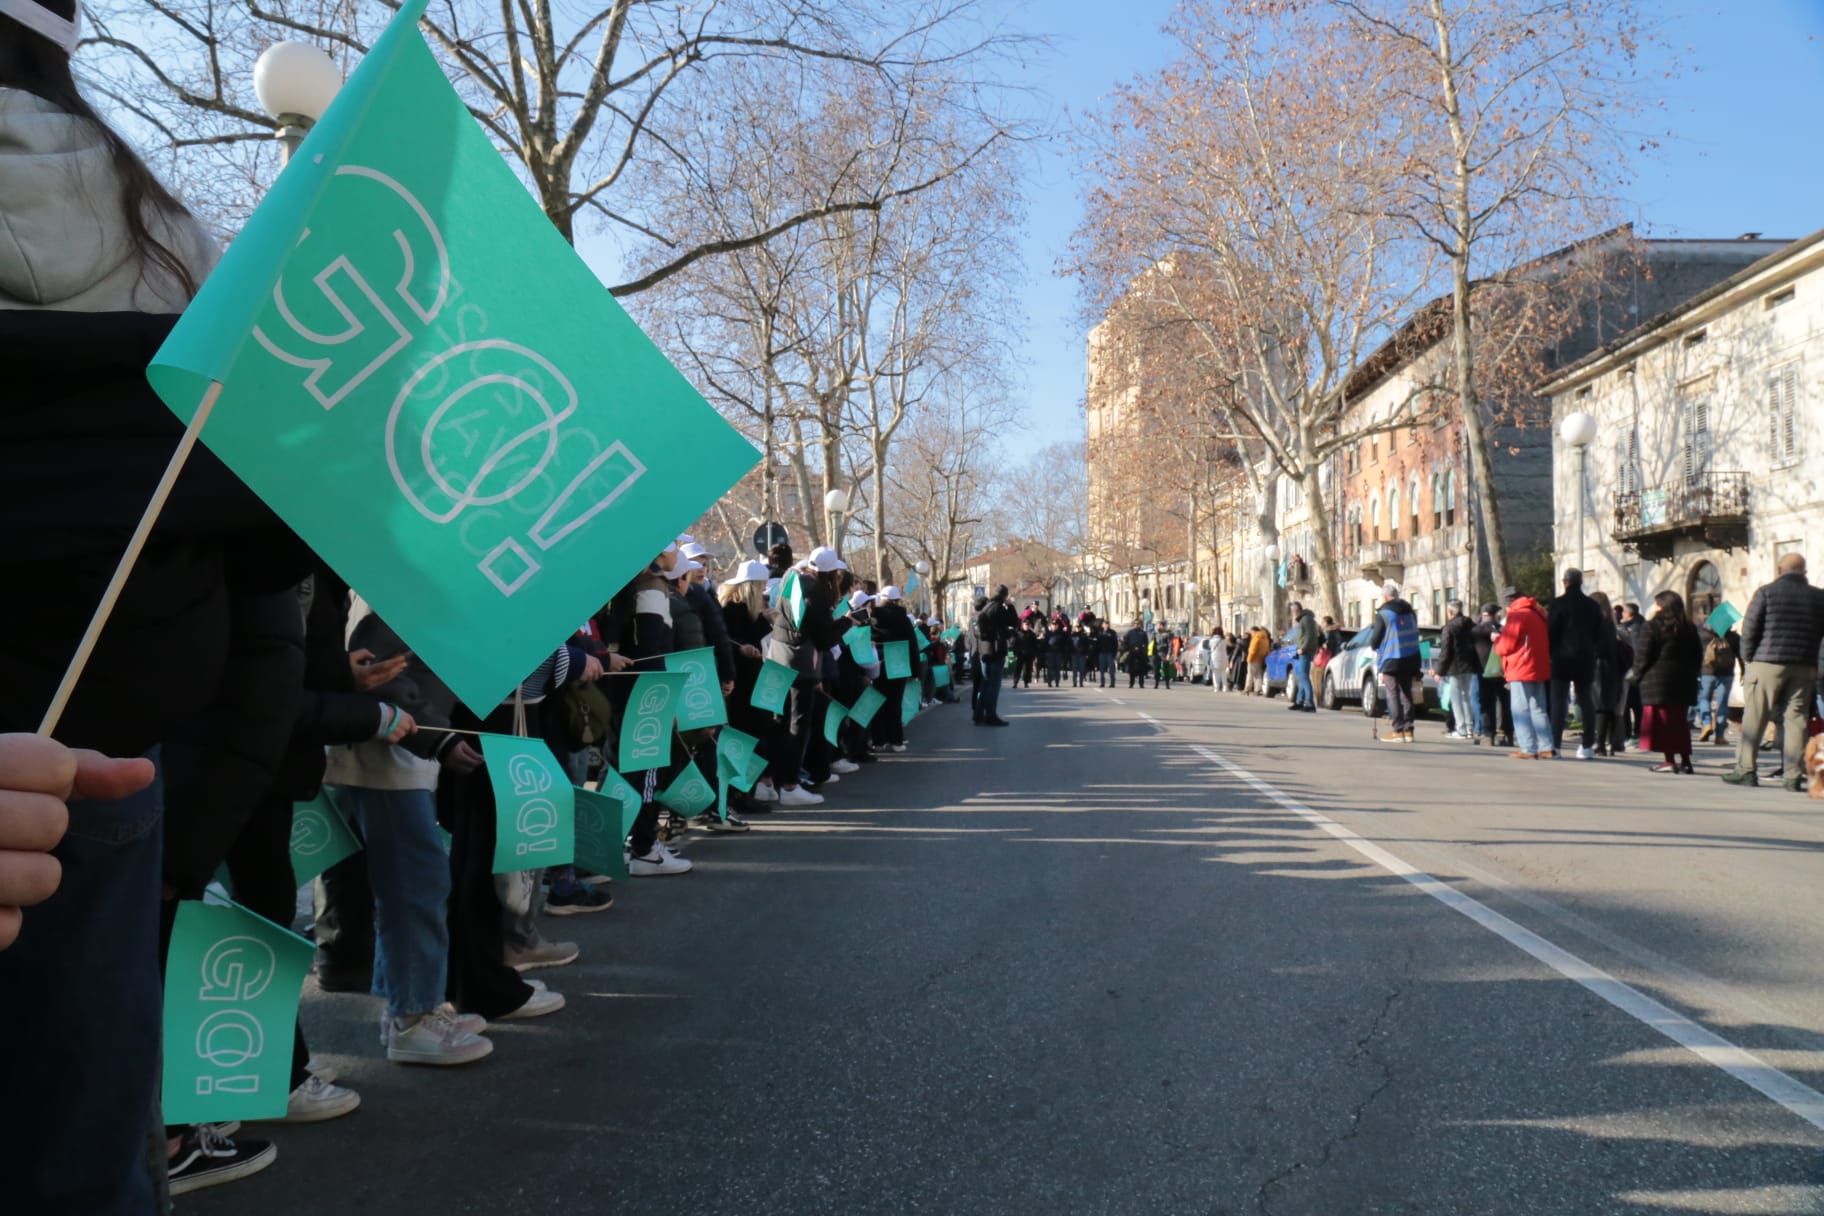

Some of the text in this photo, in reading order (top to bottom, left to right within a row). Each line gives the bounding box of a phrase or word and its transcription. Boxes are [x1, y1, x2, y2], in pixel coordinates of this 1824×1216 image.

[251, 164, 647, 596] GO!
[632, 684, 671, 759] GO!
[680, 660, 715, 721] GO!
[509, 754, 558, 856] GO!
[196, 936, 275, 1095] GO!
